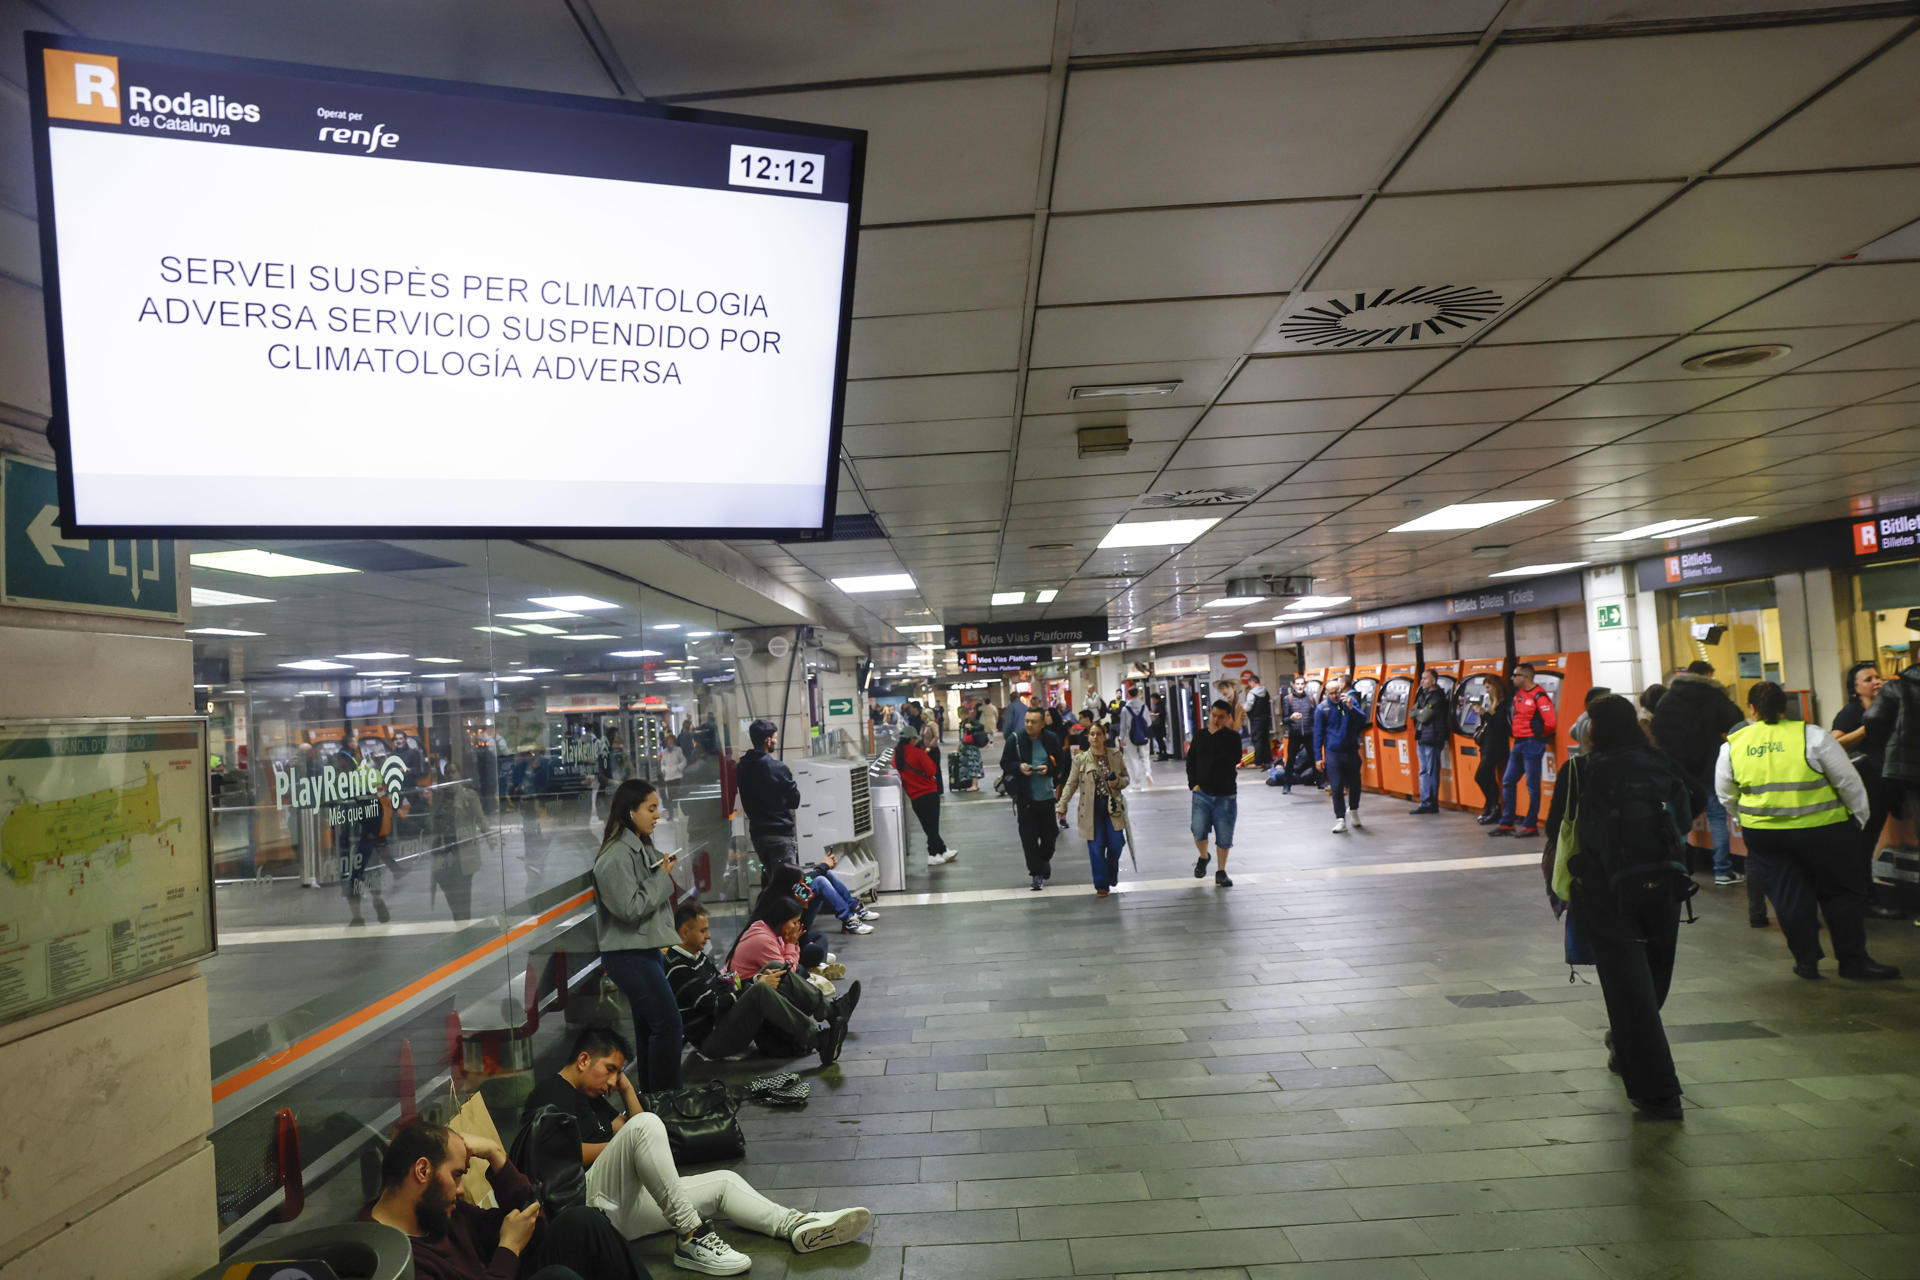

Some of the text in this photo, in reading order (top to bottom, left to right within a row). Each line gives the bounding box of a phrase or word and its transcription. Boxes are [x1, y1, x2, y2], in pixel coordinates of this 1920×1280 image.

[74, 62, 118, 108] R
[128, 86, 261, 123] Rodalies
[316, 107, 363, 122] Operat per
[128, 112, 231, 138] de Catalunya
[318, 123, 400, 154] renfe
[740, 154, 815, 185] 12:12
[160, 256, 769, 318] SERVEI SUSPÈS PER CLIMATOLOGIA
[138, 297, 781, 354] ADVERSA SERVICIO SUSPENDIDO POR
[268, 344, 682, 385] CLIMATOLOGÍA ADVERSA
[1861, 525, 1876, 546] R
[980, 634, 1004, 644] Vies
[1034, 630, 1083, 641] Platforms
[275, 759, 378, 815] PlayRenfe
[328, 799, 379, 827] Més que wifi
